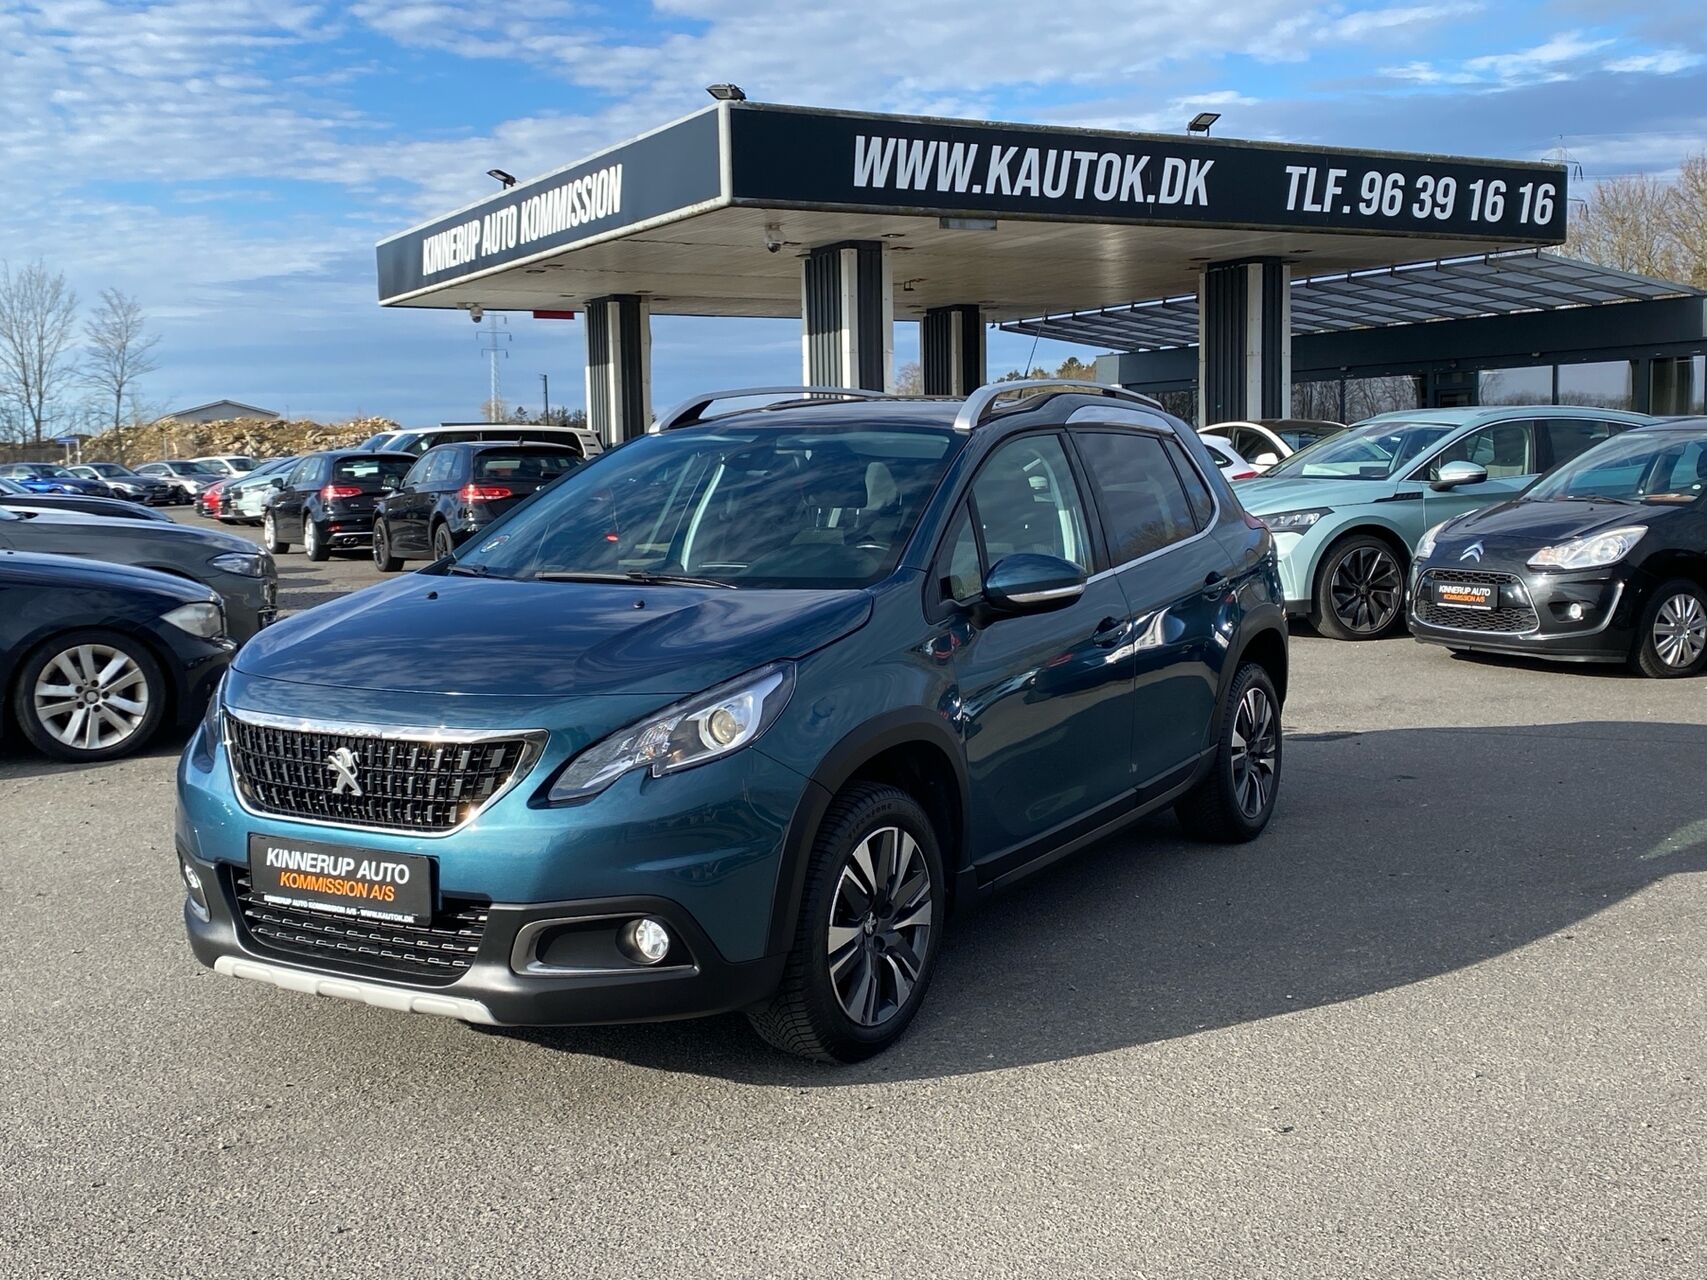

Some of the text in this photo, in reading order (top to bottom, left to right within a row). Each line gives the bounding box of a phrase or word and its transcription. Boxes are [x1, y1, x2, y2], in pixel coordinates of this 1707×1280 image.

[853, 135, 1214, 206] WWW.KAUTOK.DK
[1285, 165, 1556, 225] TLF. 96 39 16 16
[422, 163, 623, 276] KINNERUP AUTO KOMMISSION
[1471, 587, 1491, 596] AUTO
[266, 847, 410, 884] KINNERUP AUTO
[280, 871, 395, 902] KOMMISSION A/S
